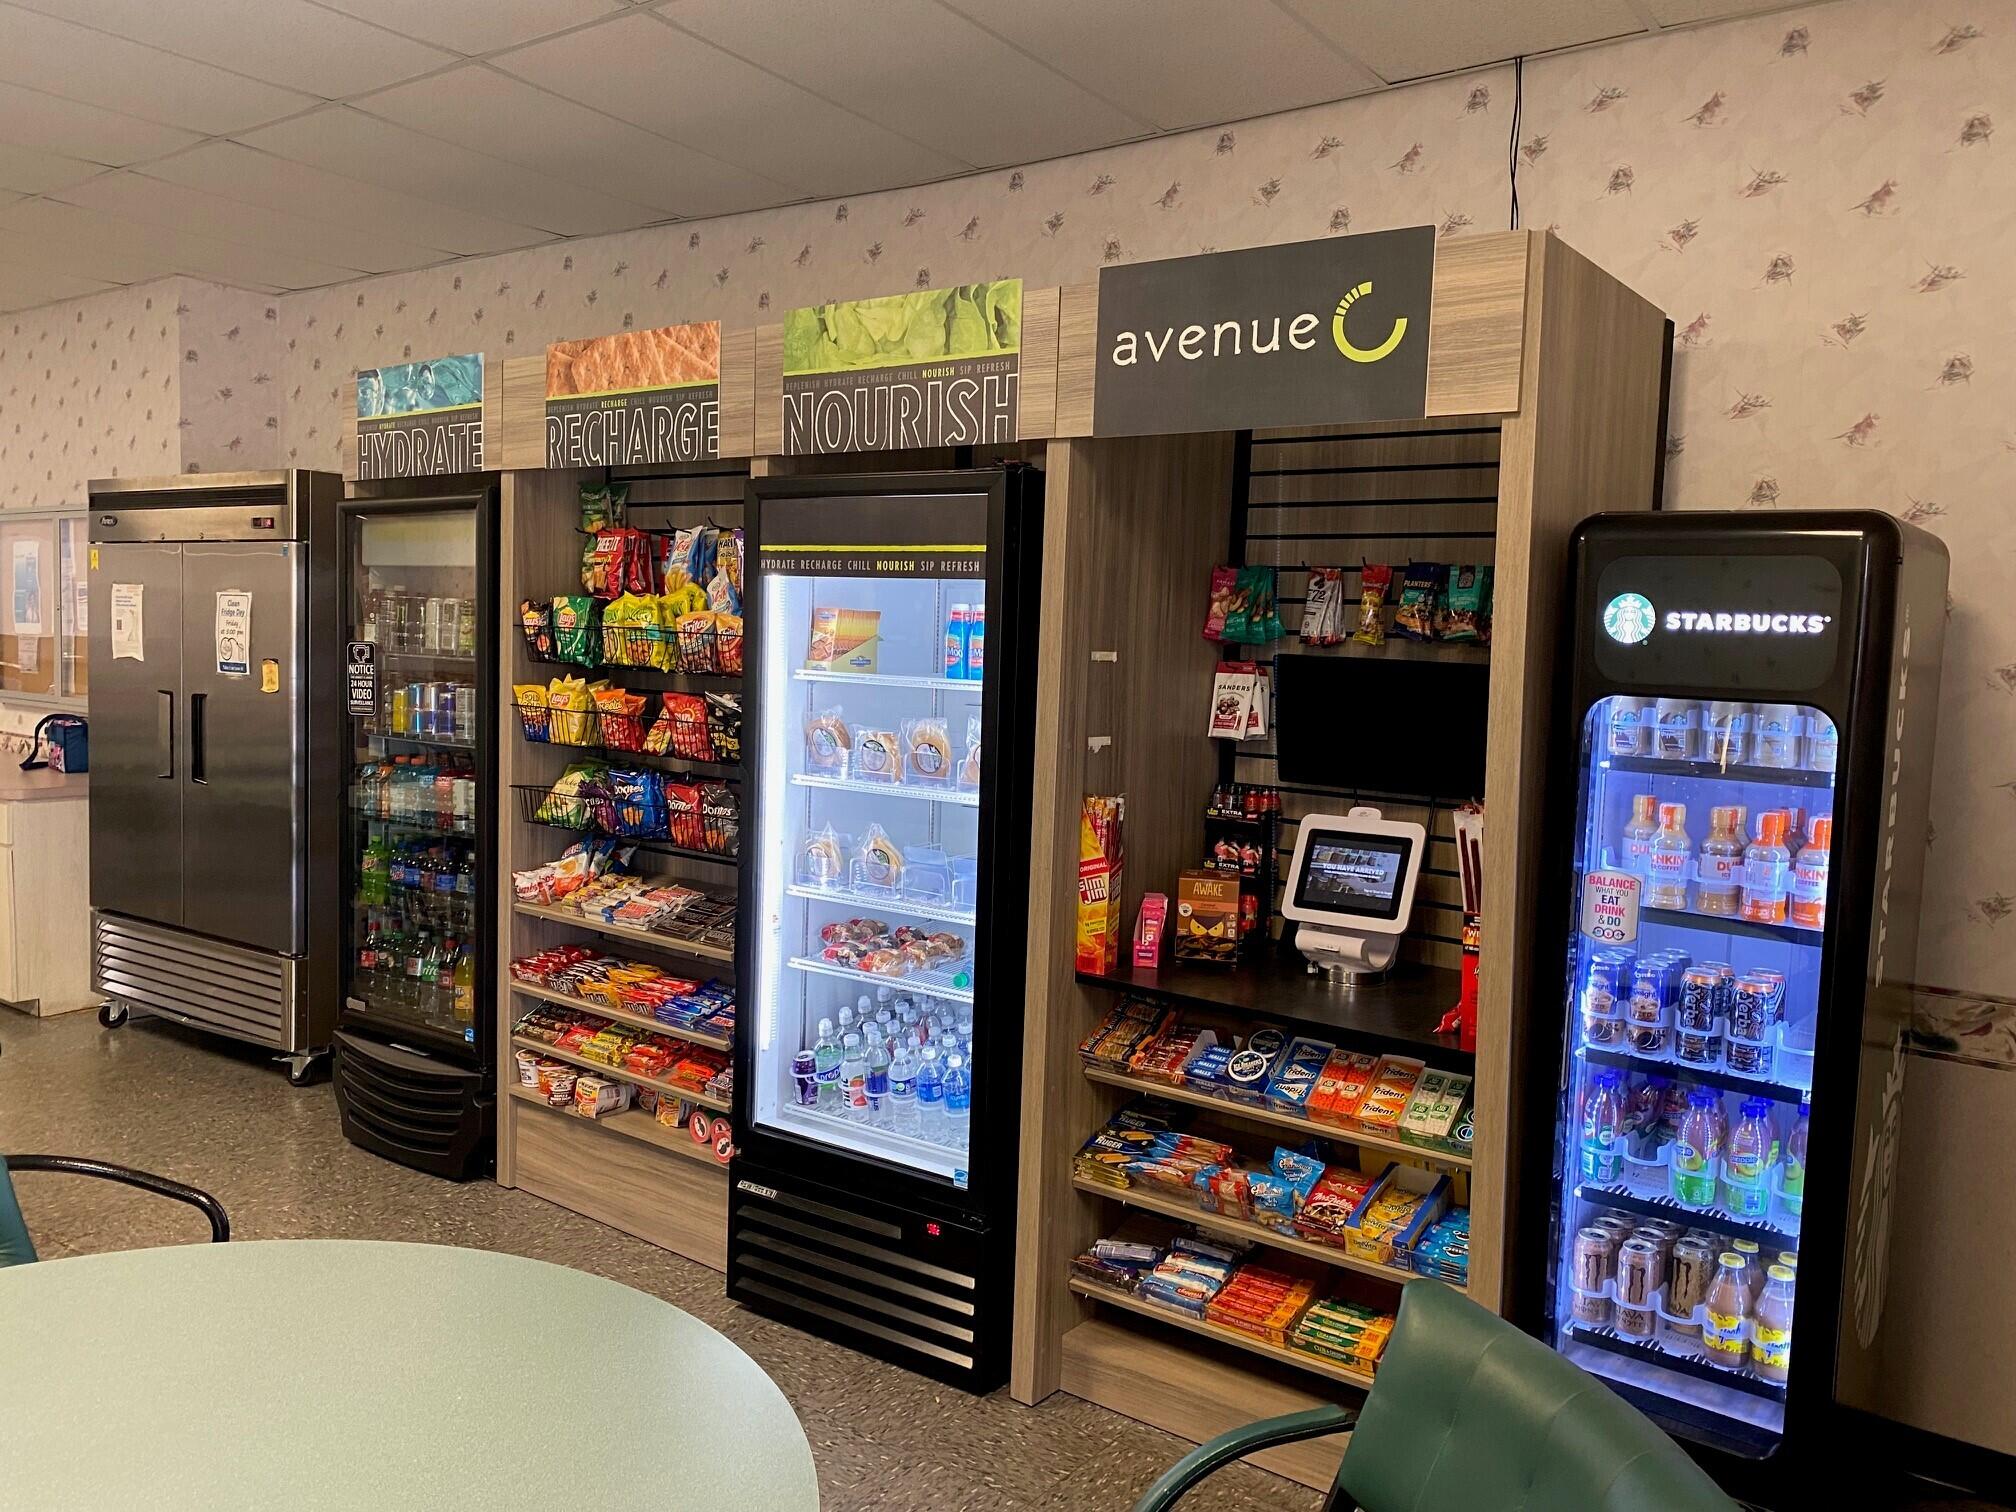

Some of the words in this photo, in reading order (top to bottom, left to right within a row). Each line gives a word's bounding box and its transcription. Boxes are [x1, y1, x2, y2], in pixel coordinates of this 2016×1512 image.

[1111, 313, 1320, 366] avenue
[857, 372, 893, 385] RECHARGE
[897, 370, 917, 381] CHILL
[922, 366, 955, 379] NOURISH
[960, 364, 972, 375] SIP
[976, 361, 1011, 373] REFRESH
[601, 399, 627, 408] RECHARGE
[783, 373, 1018, 455] NOURISH
[545, 401, 719, 468] RECHARGE
[357, 422, 483, 480] HYDRATE
[761, 559, 795, 570] HYDRATE
[800, 559, 842, 570] RECHARGE
[847, 560, 871, 571] CHILL
[876, 560, 915, 571] NOURISH
[920, 561, 935, 571] SIP
[940, 561, 980, 572] REFRESH
[1403, 580, 1432, 588] PLANTERS
[1665, 612, 1826, 633] STARBUCKS
[348, 664, 374, 674] NOTICE
[350, 680, 357, 688] 24
[357, 680, 373, 688] HOUR
[1218, 684, 1250, 692] SANDERS
[351, 688, 372, 700] VIDEO
[1876, 627, 1911, 988] STARBUCKS
[1079, 861, 1108, 873] ORIGINAL
[1337, 864, 1355, 872] HAVE
[1354, 866, 1385, 875] ARRIVED
[1589, 875, 1636, 890] BALANCE
[1192, 881, 1223, 897] AWAKE
[1595, 886, 1613, 894] WHAT
[1615, 889, 1629, 897] YOU
[1601, 894, 1620, 905] EAT
[1594, 904, 1625, 917] DRINK
[1598, 914, 1604, 924] &
[1607, 916, 1621, 926] DO
[1208, 1053, 1226, 1062] HALLS
[1296, 1048, 1326, 1060] Trident
[1197, 1060, 1217, 1069] HALLS
[1193, 1068, 1212, 1076] HALLS
[1285, 1066, 1316, 1079] Trident
[1383, 1067, 1415, 1079] Trident
[1275, 1083, 1306, 1097] Trident
[1373, 1086, 1405, 1099] Trident
[1362, 1103, 1394, 1116] Trident
[1360, 1123, 1388, 1133] Trident
[1095, 1136, 1123, 1150] RUGER
